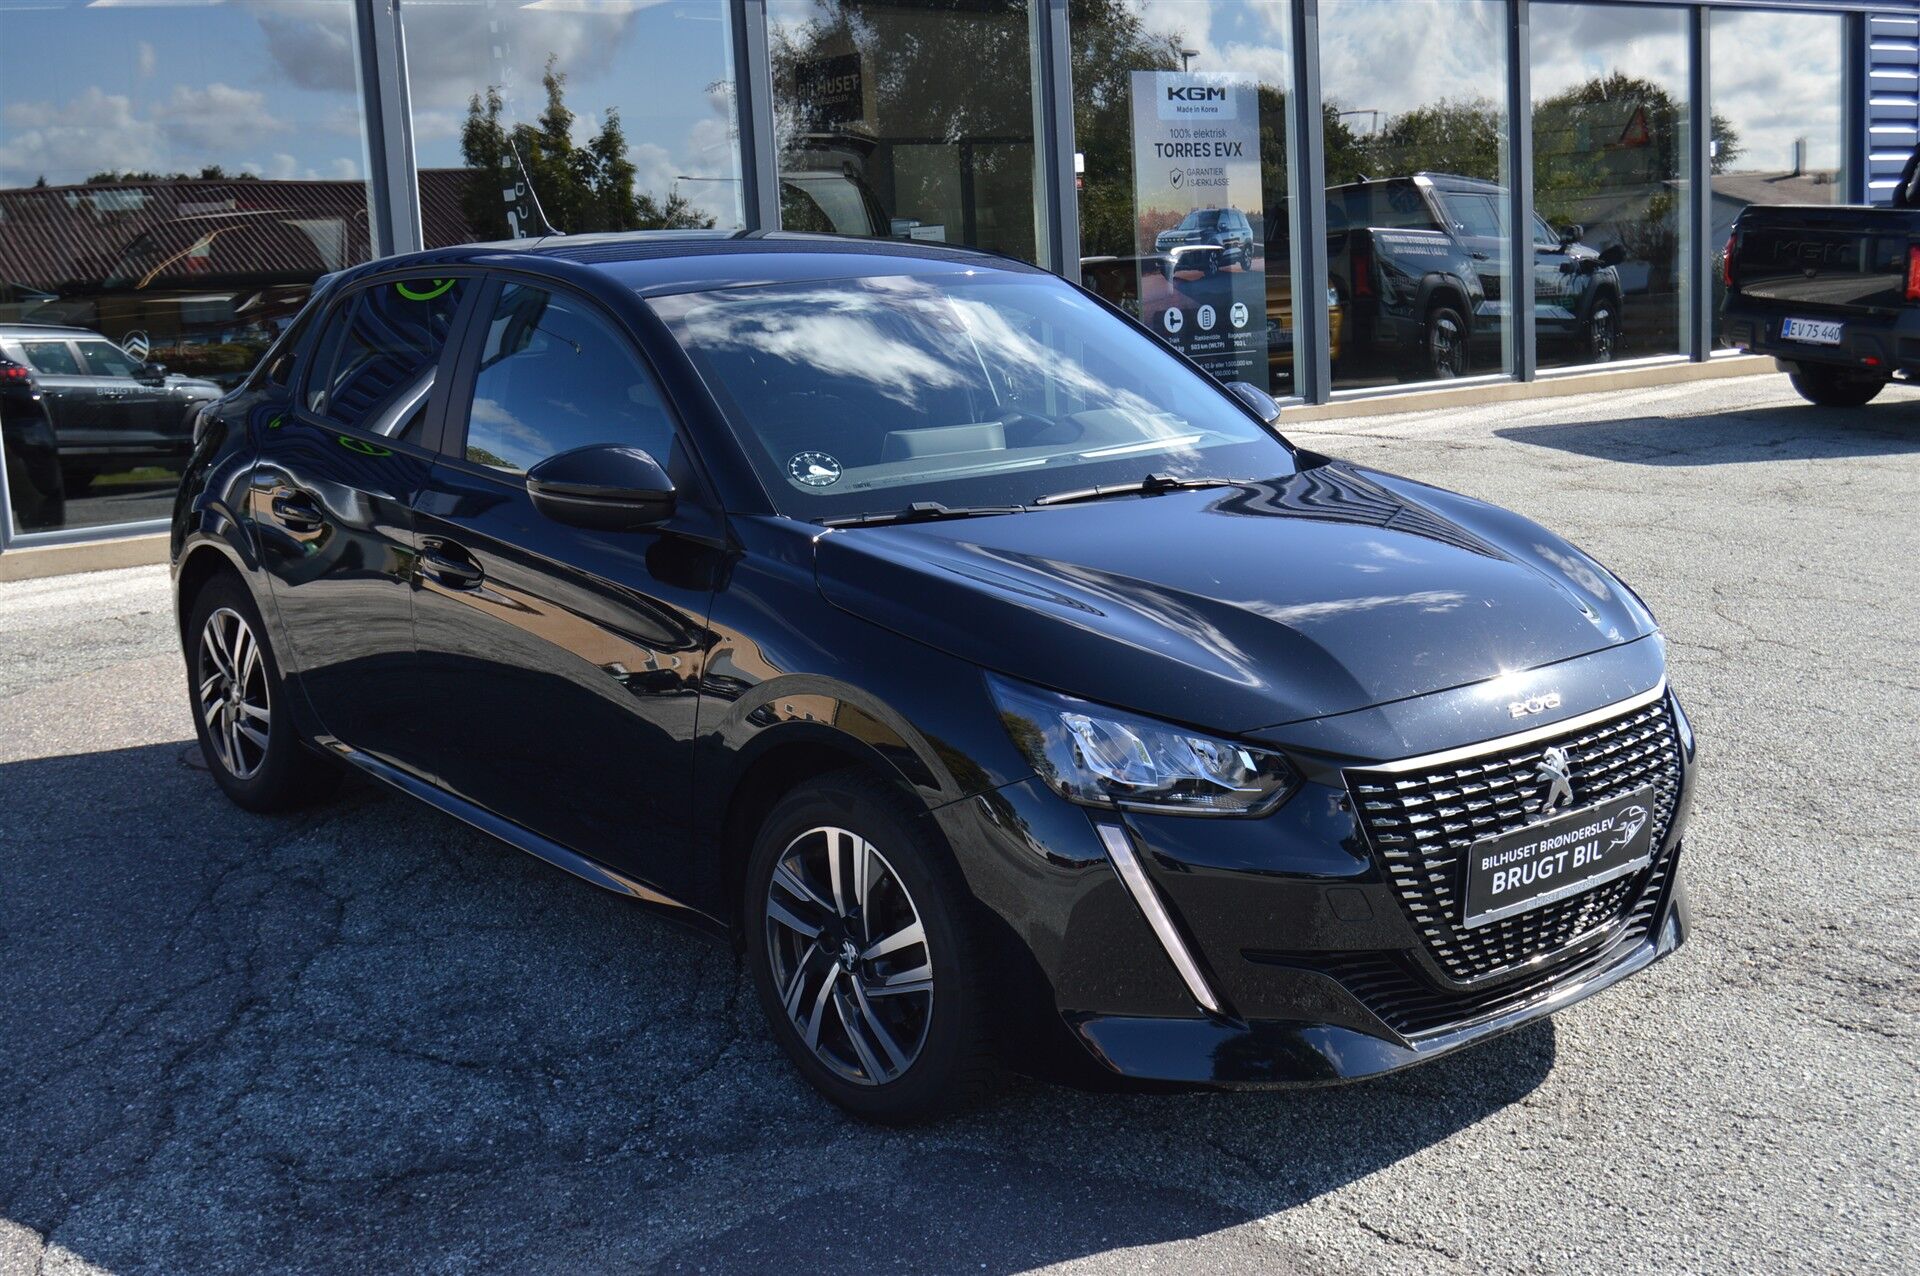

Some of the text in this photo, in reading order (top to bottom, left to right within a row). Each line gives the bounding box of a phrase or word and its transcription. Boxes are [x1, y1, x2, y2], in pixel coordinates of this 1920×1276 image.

[1167, 87, 1226, 101] KGM
[1170, 128, 1228, 139] 100% elektrisk
[1154, 142, 1243, 158] TORRES EVX
[1186, 167, 1224, 177] GARANTIER
[1191, 178, 1230, 187] SÆRKLASSE
[1790, 322, 1841, 341] EV 75 440
[1508, 692, 1561, 719] 208
[1481, 817, 1615, 871] BILHUSET BRØNDERSLEV
[1491, 840, 1603, 895] BRUGT BIL
